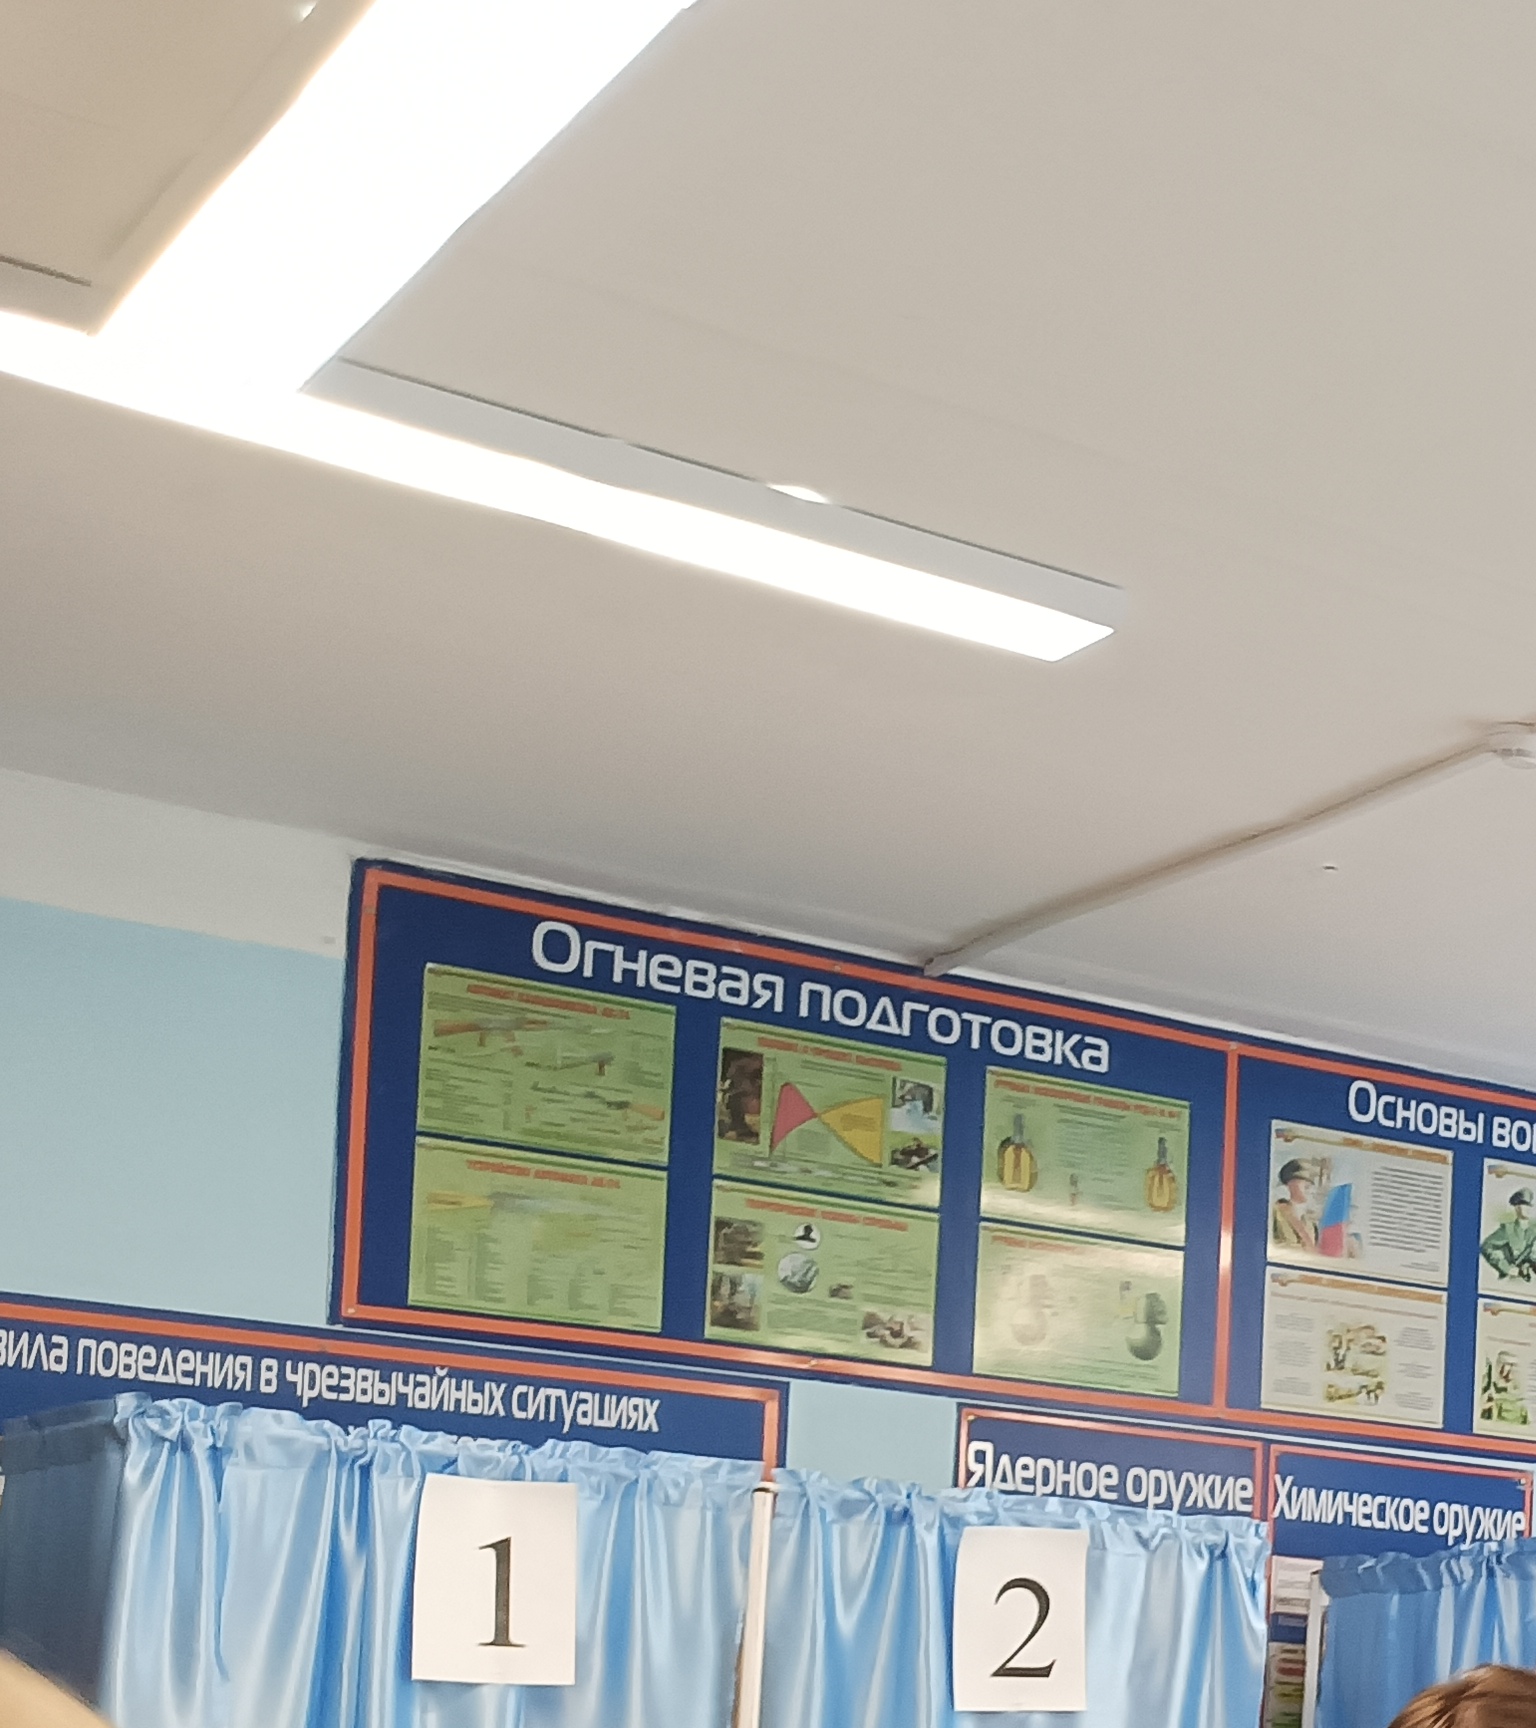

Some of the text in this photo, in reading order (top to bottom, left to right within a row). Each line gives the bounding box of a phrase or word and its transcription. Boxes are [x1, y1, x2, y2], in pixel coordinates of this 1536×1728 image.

[531, 920, 1110, 1074] Огневая подготовка
[1348, 1080, 1485, 1145] Основы
[76, 1337, 253, 1392] поведения
[259, 1356, 279, 1395] в
[285, 1359, 507, 1417] чрезвычайных
[512, 1384, 661, 1434] ситуациях
[966, 1440, 1254, 1514] Ядерное оружие
[1272, 1473, 1526, 1550] Химическое оружие
[479, 1536, 526, 1648] 1
[989, 1576, 1057, 1679] 2
